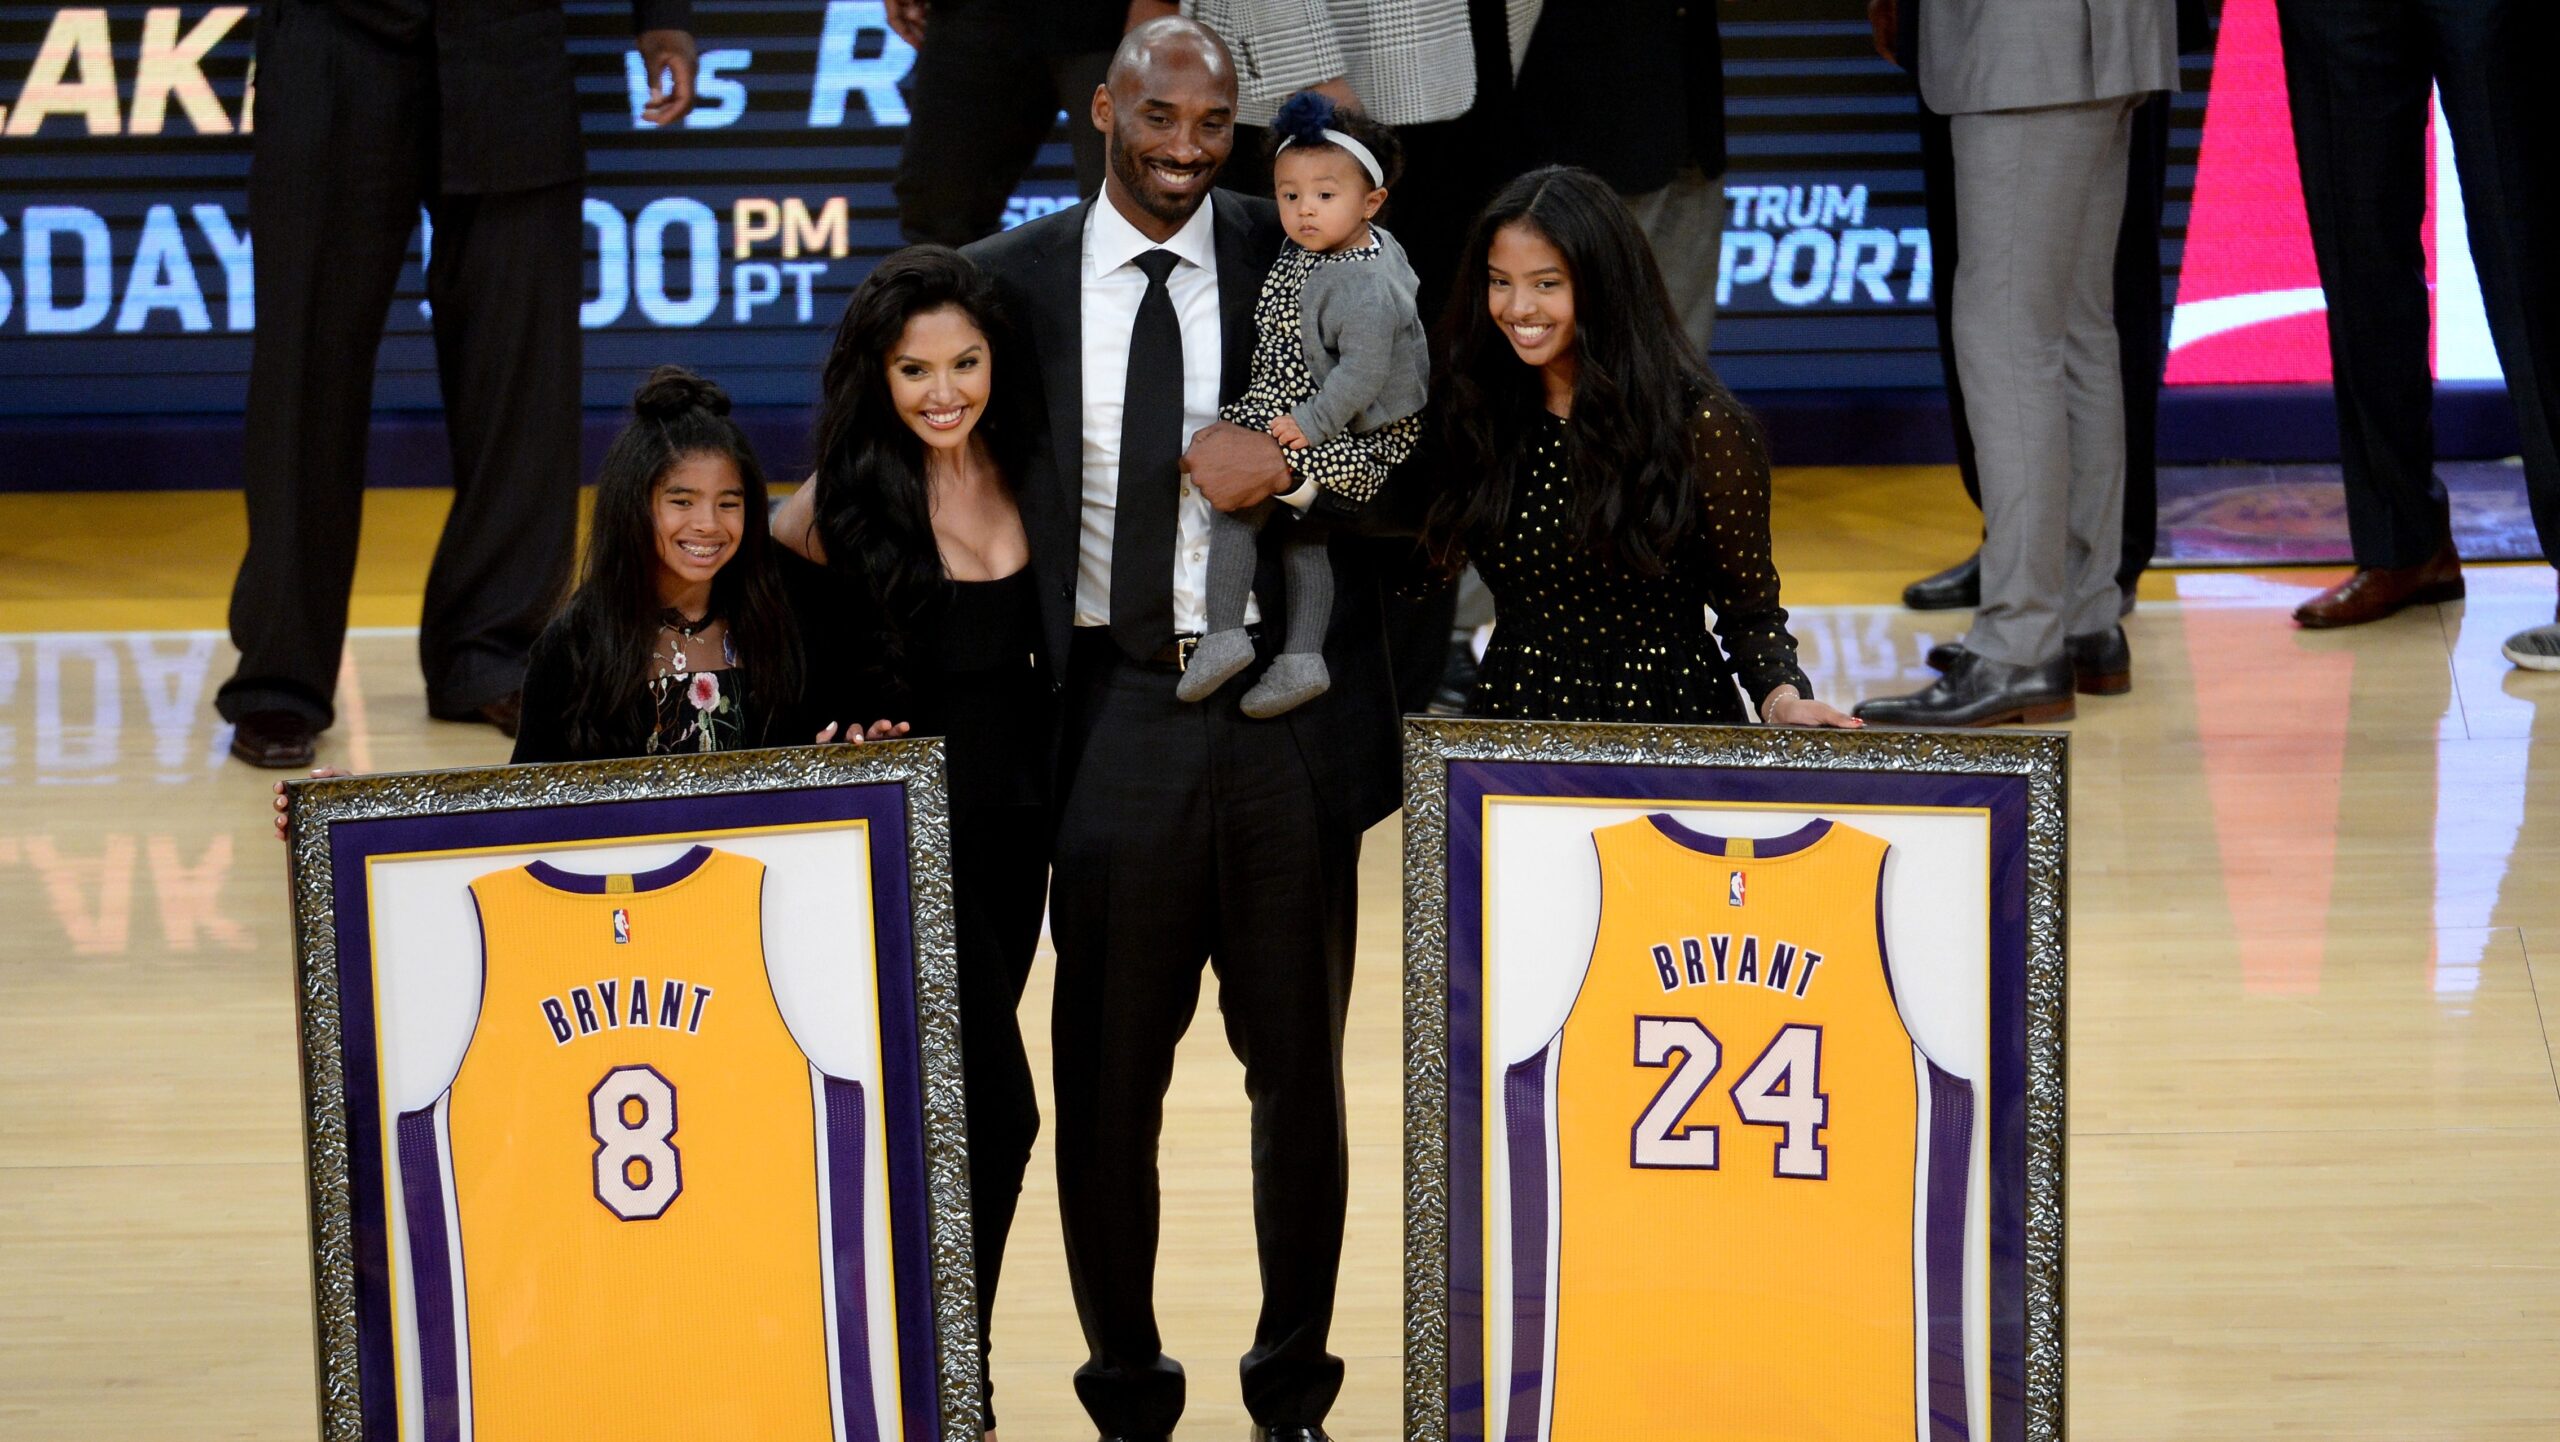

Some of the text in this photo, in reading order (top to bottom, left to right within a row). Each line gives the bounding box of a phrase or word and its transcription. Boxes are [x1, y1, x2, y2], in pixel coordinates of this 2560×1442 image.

[0, 7, 256, 135] AK
[0, 203, 255, 332] DAY
[733, 197, 848, 258] PM
[733, 262, 828, 323] PT
[539, 976, 713, 1047] BRYANT
[1651, 933, 1824, 1000] BRYANT
[588, 1063, 683, 1222] 8
[1630, 1014, 1829, 1181] 24
